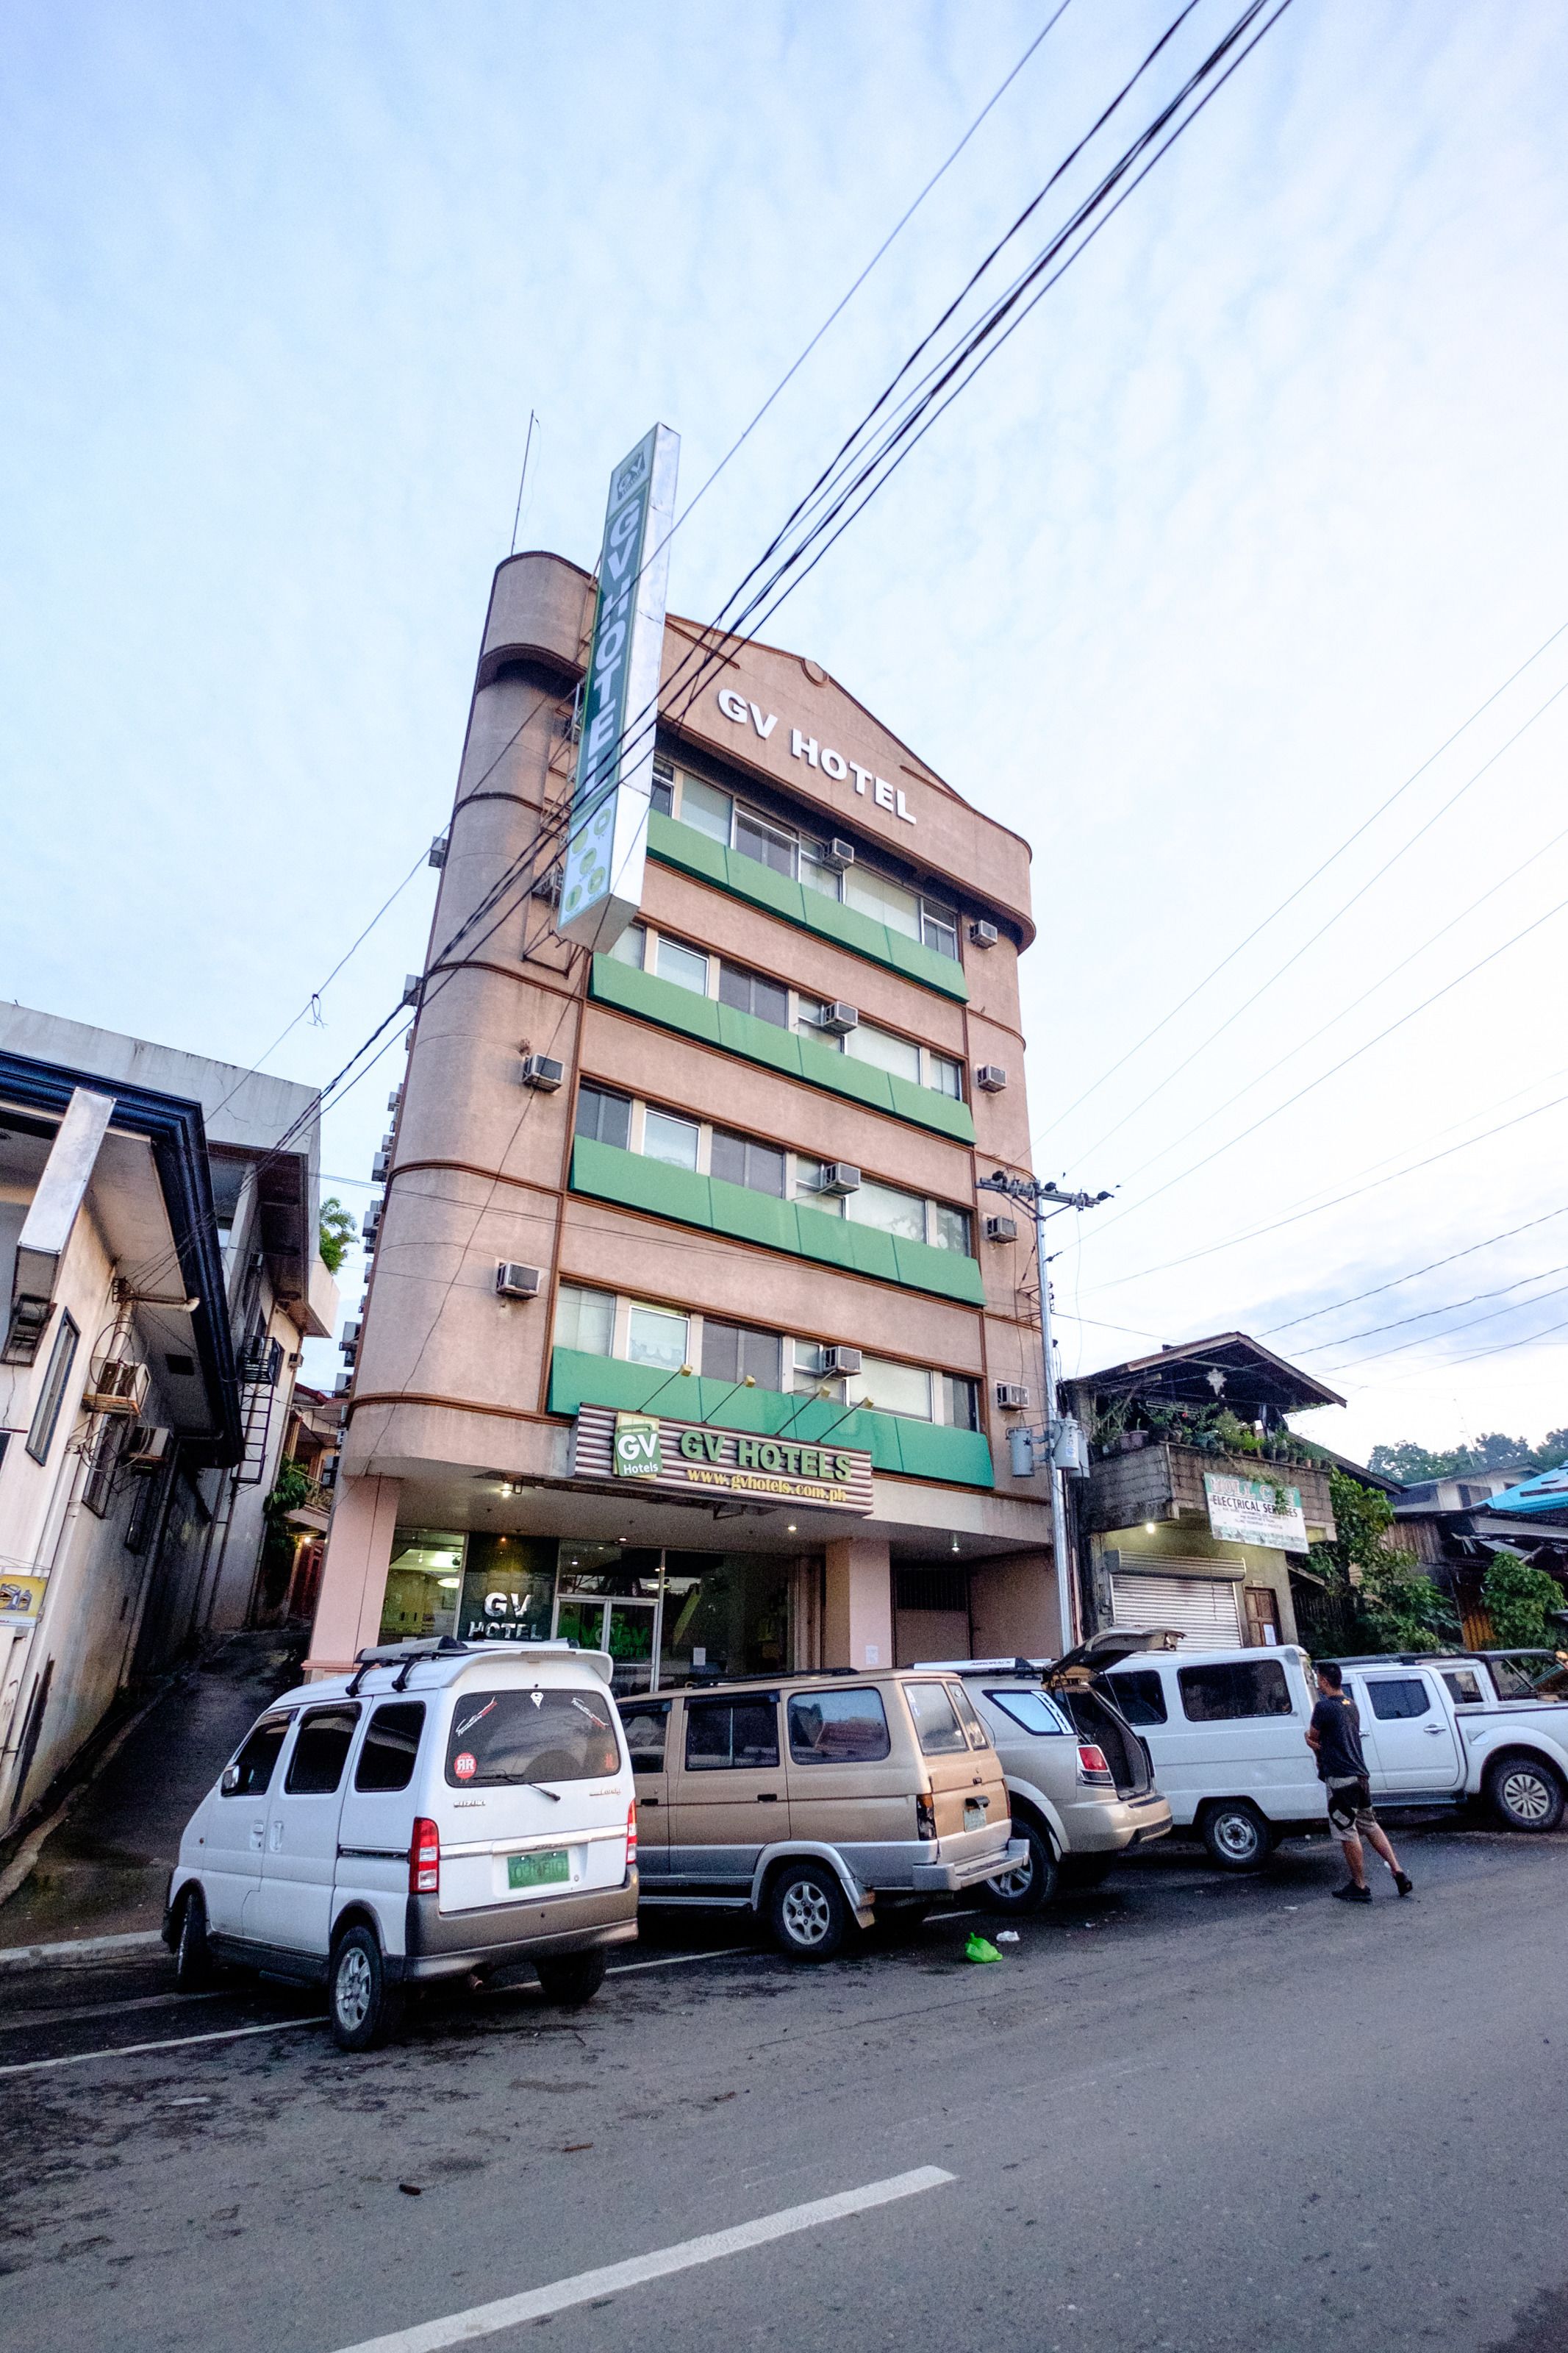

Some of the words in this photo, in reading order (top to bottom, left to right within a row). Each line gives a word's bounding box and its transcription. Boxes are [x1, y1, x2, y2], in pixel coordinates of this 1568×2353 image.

[607, 499, 640, 582] GV
[584, 574, 631, 798] HOTEL
[717, 689, 778, 740] GV
[791, 728, 916, 824] HOTEL
[618, 1433, 657, 1460] GV
[681, 1430, 725, 1462] GV
[737, 1439, 851, 1481] HOTELS
[623, 1462, 659, 1475] Hotels
[687, 1469, 847, 1502] www.gvhotels.com.ph
[1212, 1494, 1261, 1512] ELECTRICAL
[484, 1592, 534, 1618] GV
[468, 1621, 543, 1640] HOTEL
